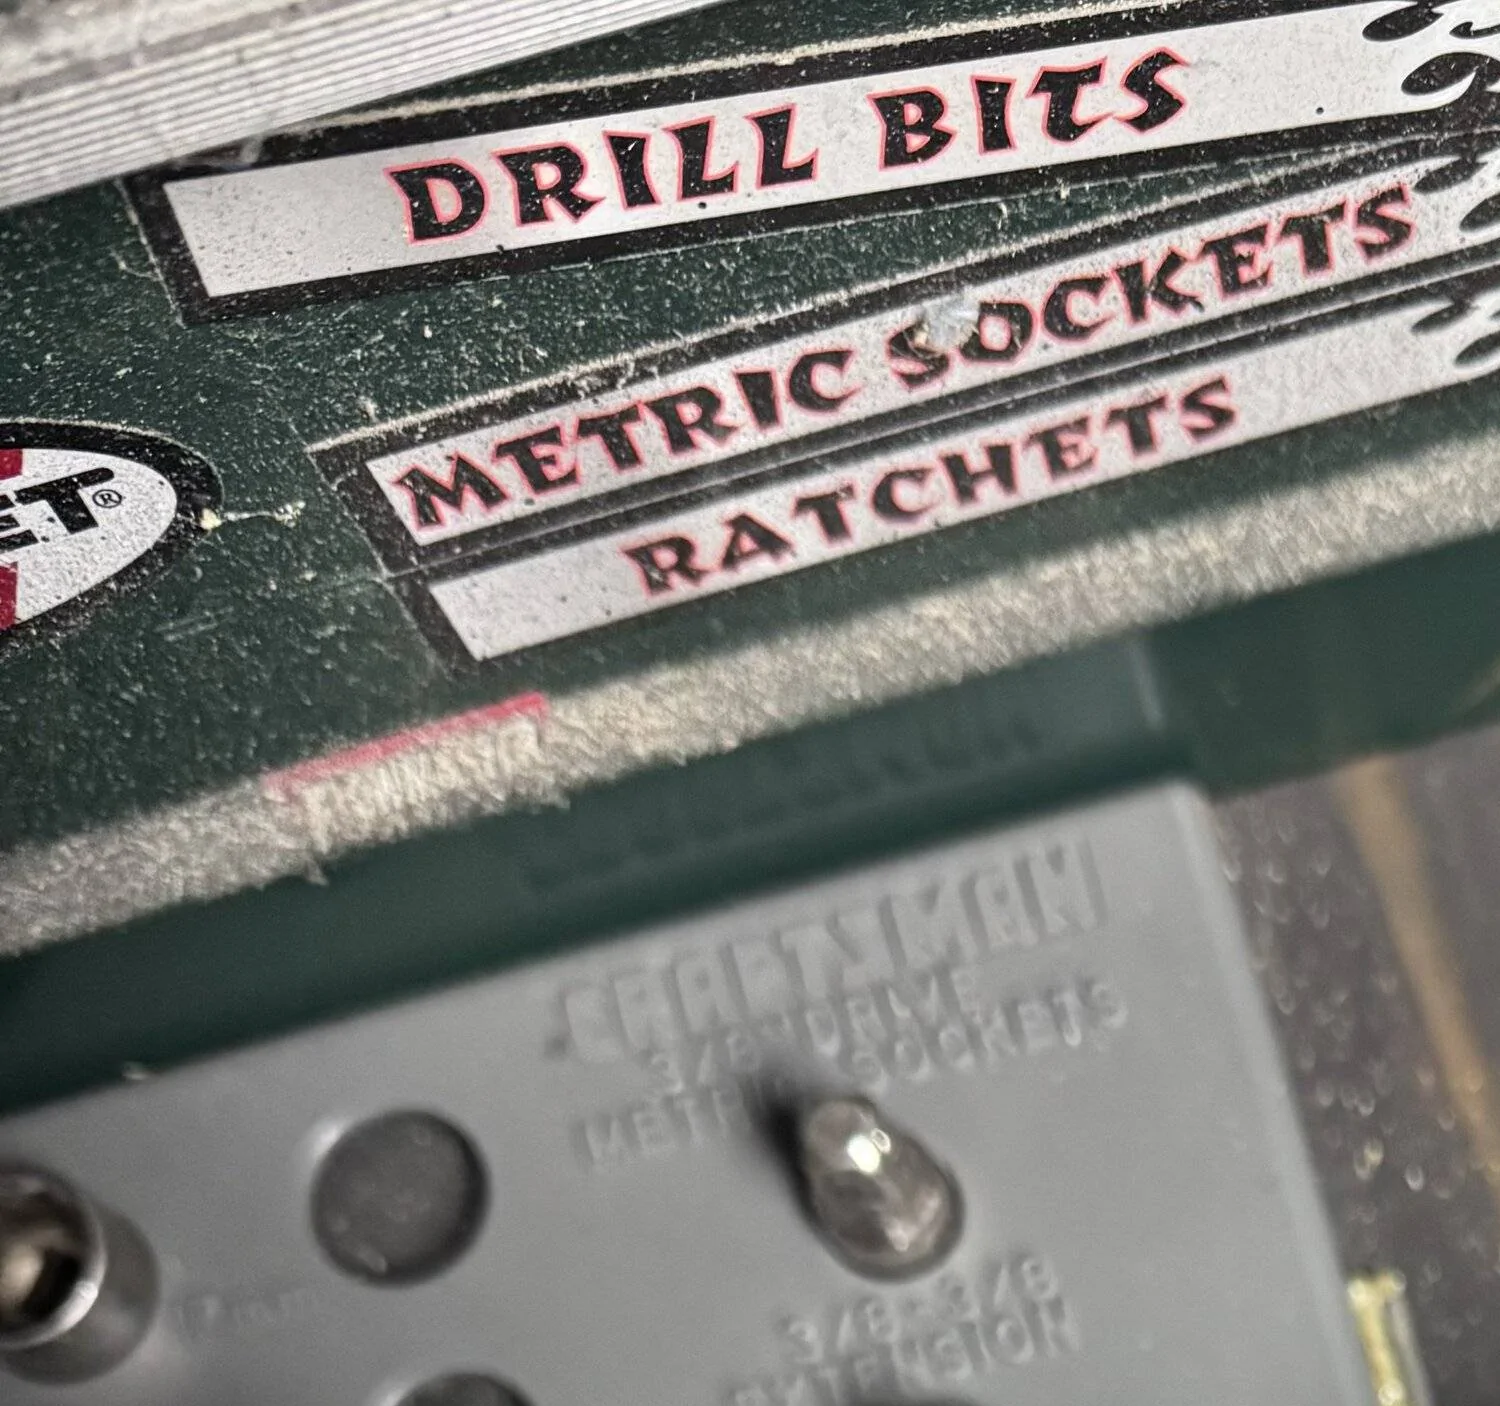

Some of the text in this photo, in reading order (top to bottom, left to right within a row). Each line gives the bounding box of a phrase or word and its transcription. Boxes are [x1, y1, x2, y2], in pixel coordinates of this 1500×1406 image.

[383, 46, 1190, 245] DRILL BITS
[392, 182, 1418, 532] METRIC SOCKETS
[618, 372, 1242, 599] RATCHETS
[560, 835, 1106, 1064] CRAFTSMAN
[848, 975, 1127, 1096] SOCKETS
